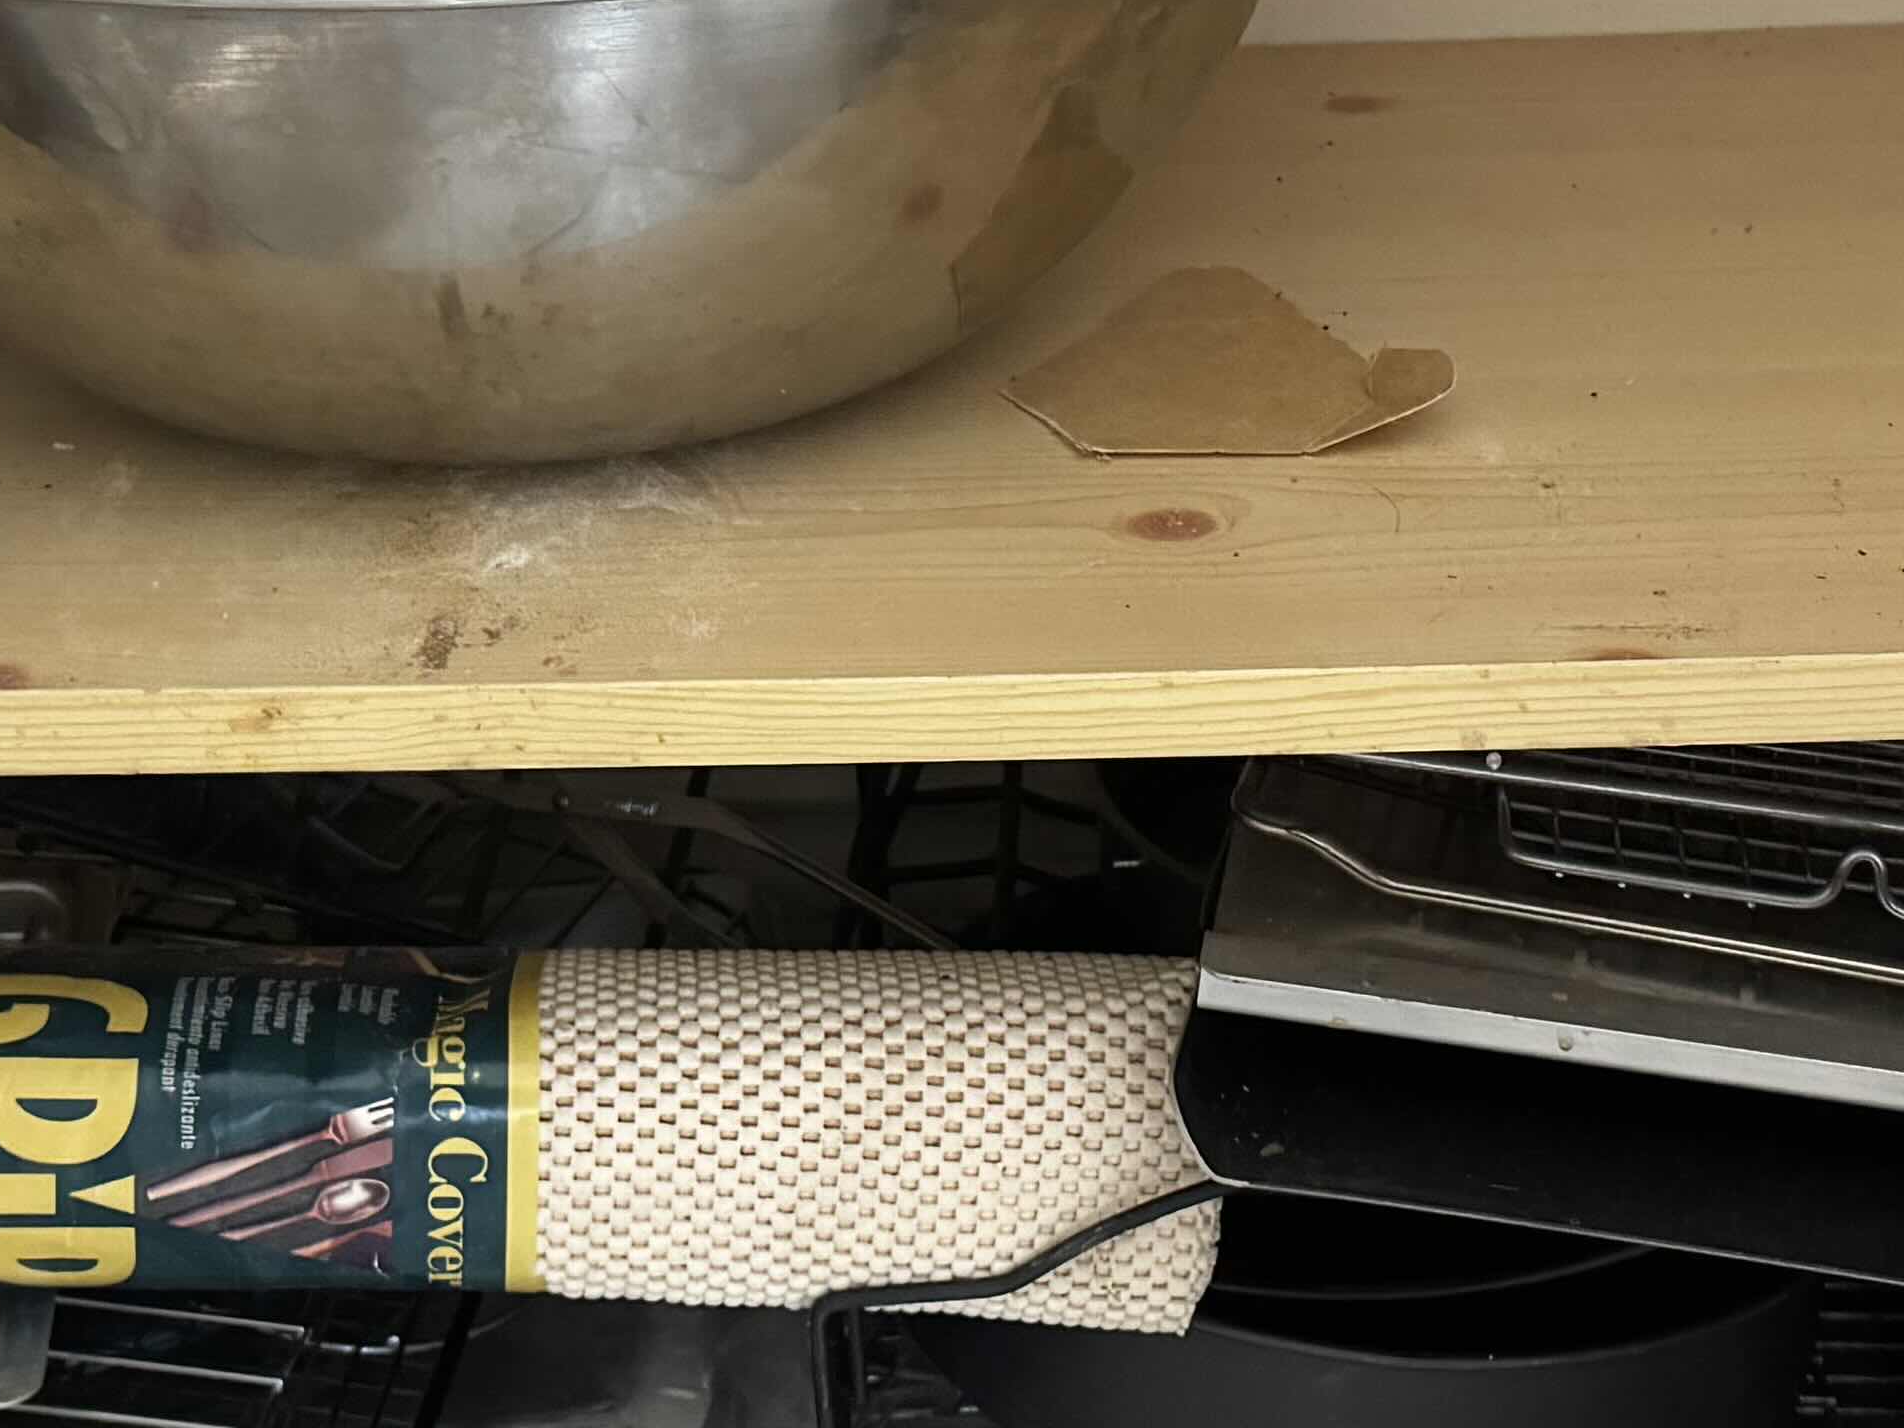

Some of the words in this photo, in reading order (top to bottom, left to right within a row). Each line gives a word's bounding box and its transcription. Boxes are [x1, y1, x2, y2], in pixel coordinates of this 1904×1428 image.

[208, 1020, 229, 1051] Liner
[209, 995, 234, 1020] Slip
[411, 988, 491, 1122] Magic
[180, 1048, 202, 1150] antideslizante
[427, 1137, 489, 1288] Cover
